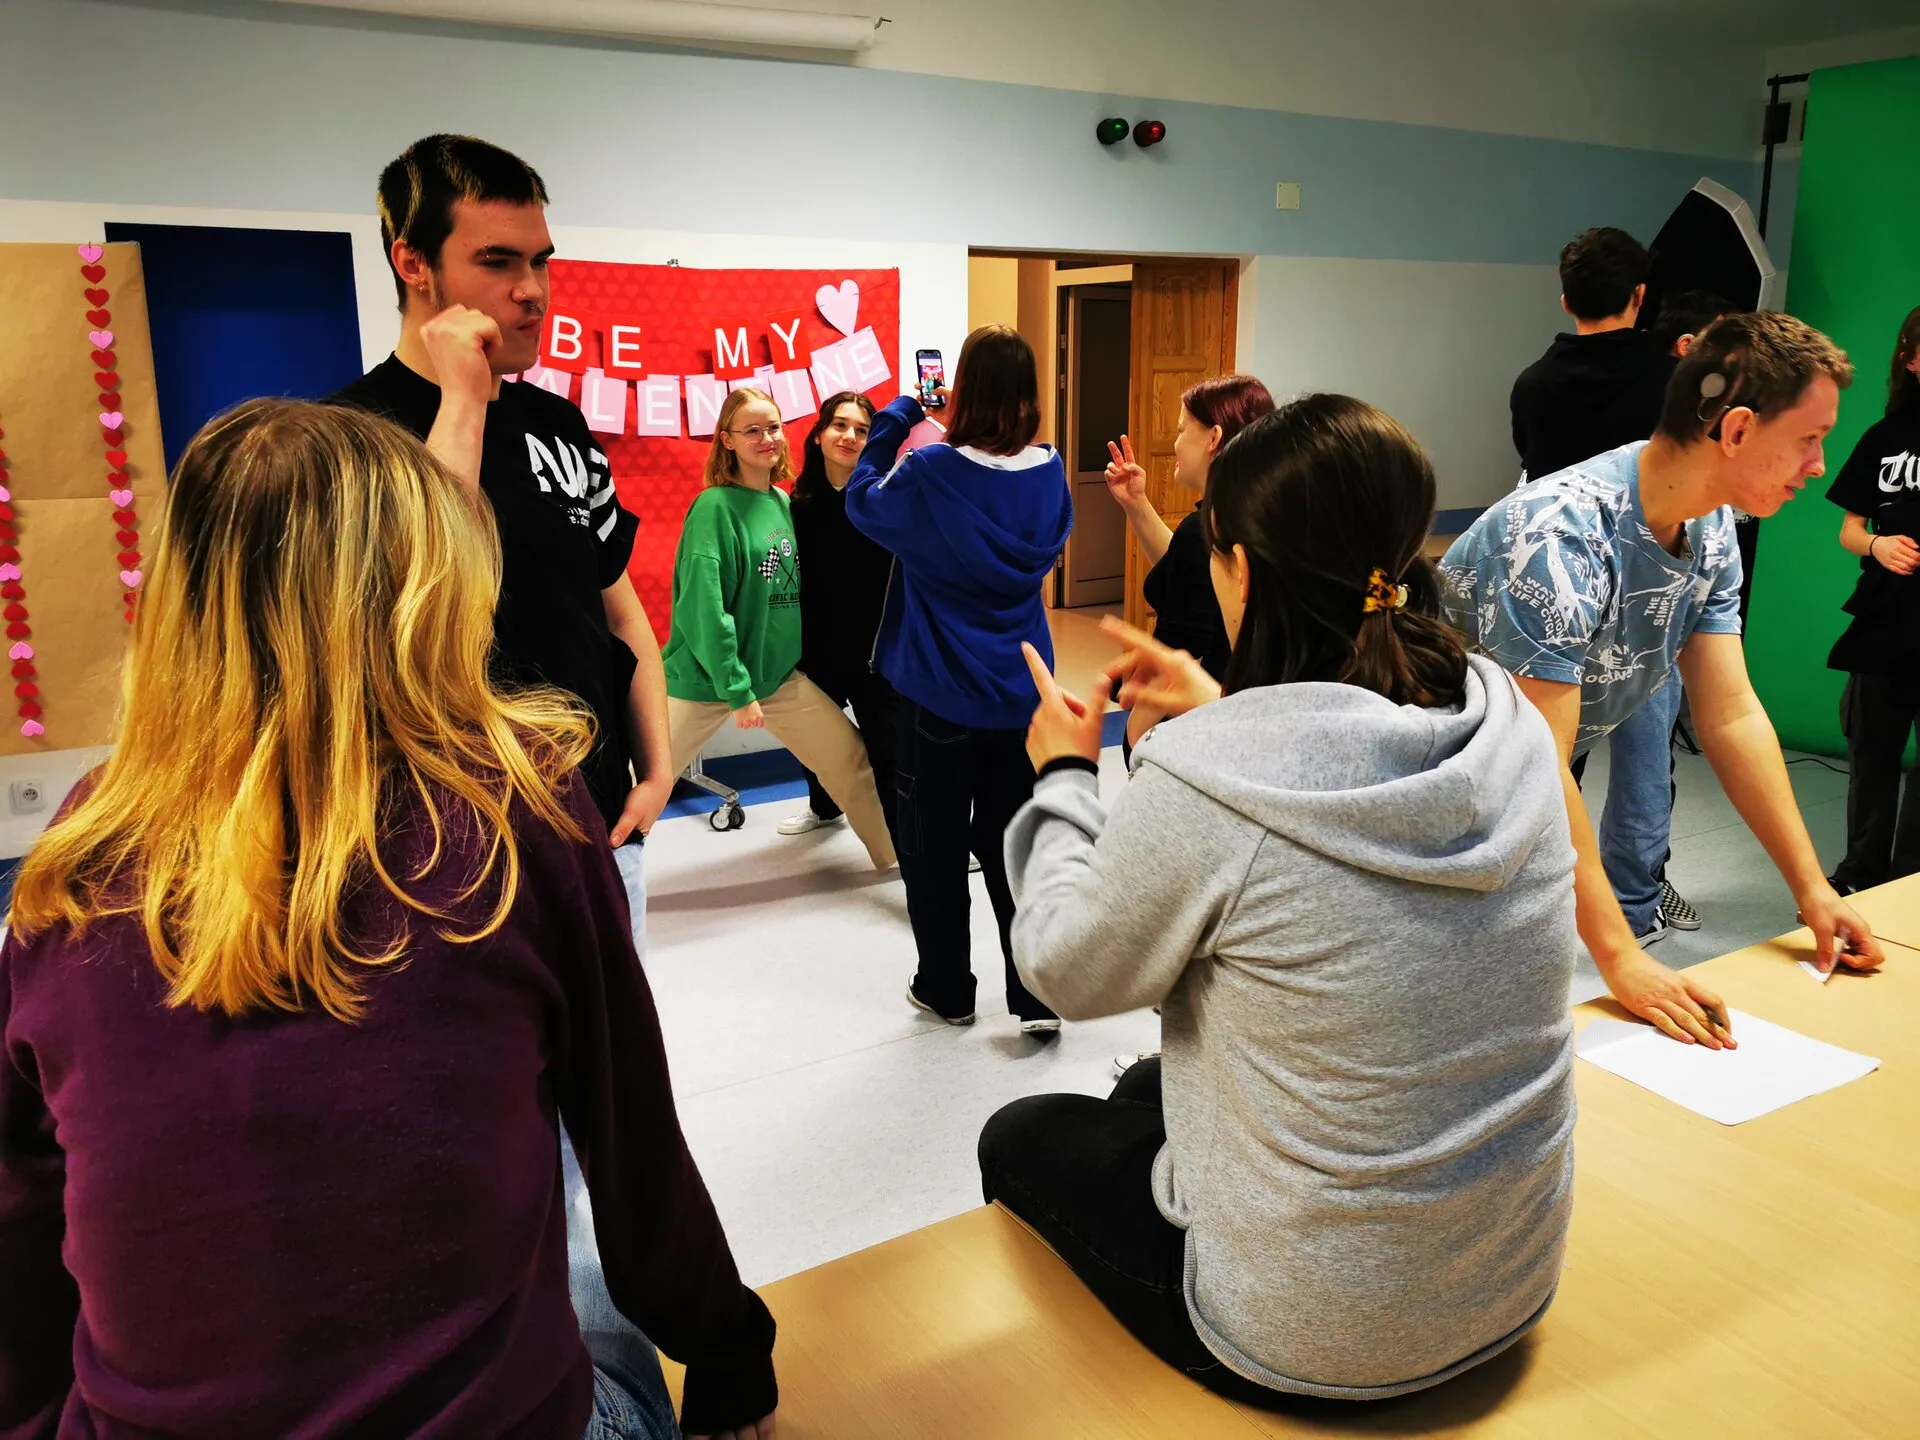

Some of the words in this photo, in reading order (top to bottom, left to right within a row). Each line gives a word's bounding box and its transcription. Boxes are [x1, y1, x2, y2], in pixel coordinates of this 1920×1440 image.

[550, 315, 642, 369] BE
[714, 318, 801, 369] MY
[534, 338, 885, 427] ALENINE
[1509, 586, 1541, 608] LIFE
[1540, 608, 1556, 642] CYCL
[1643, 597, 1661, 616] THE
